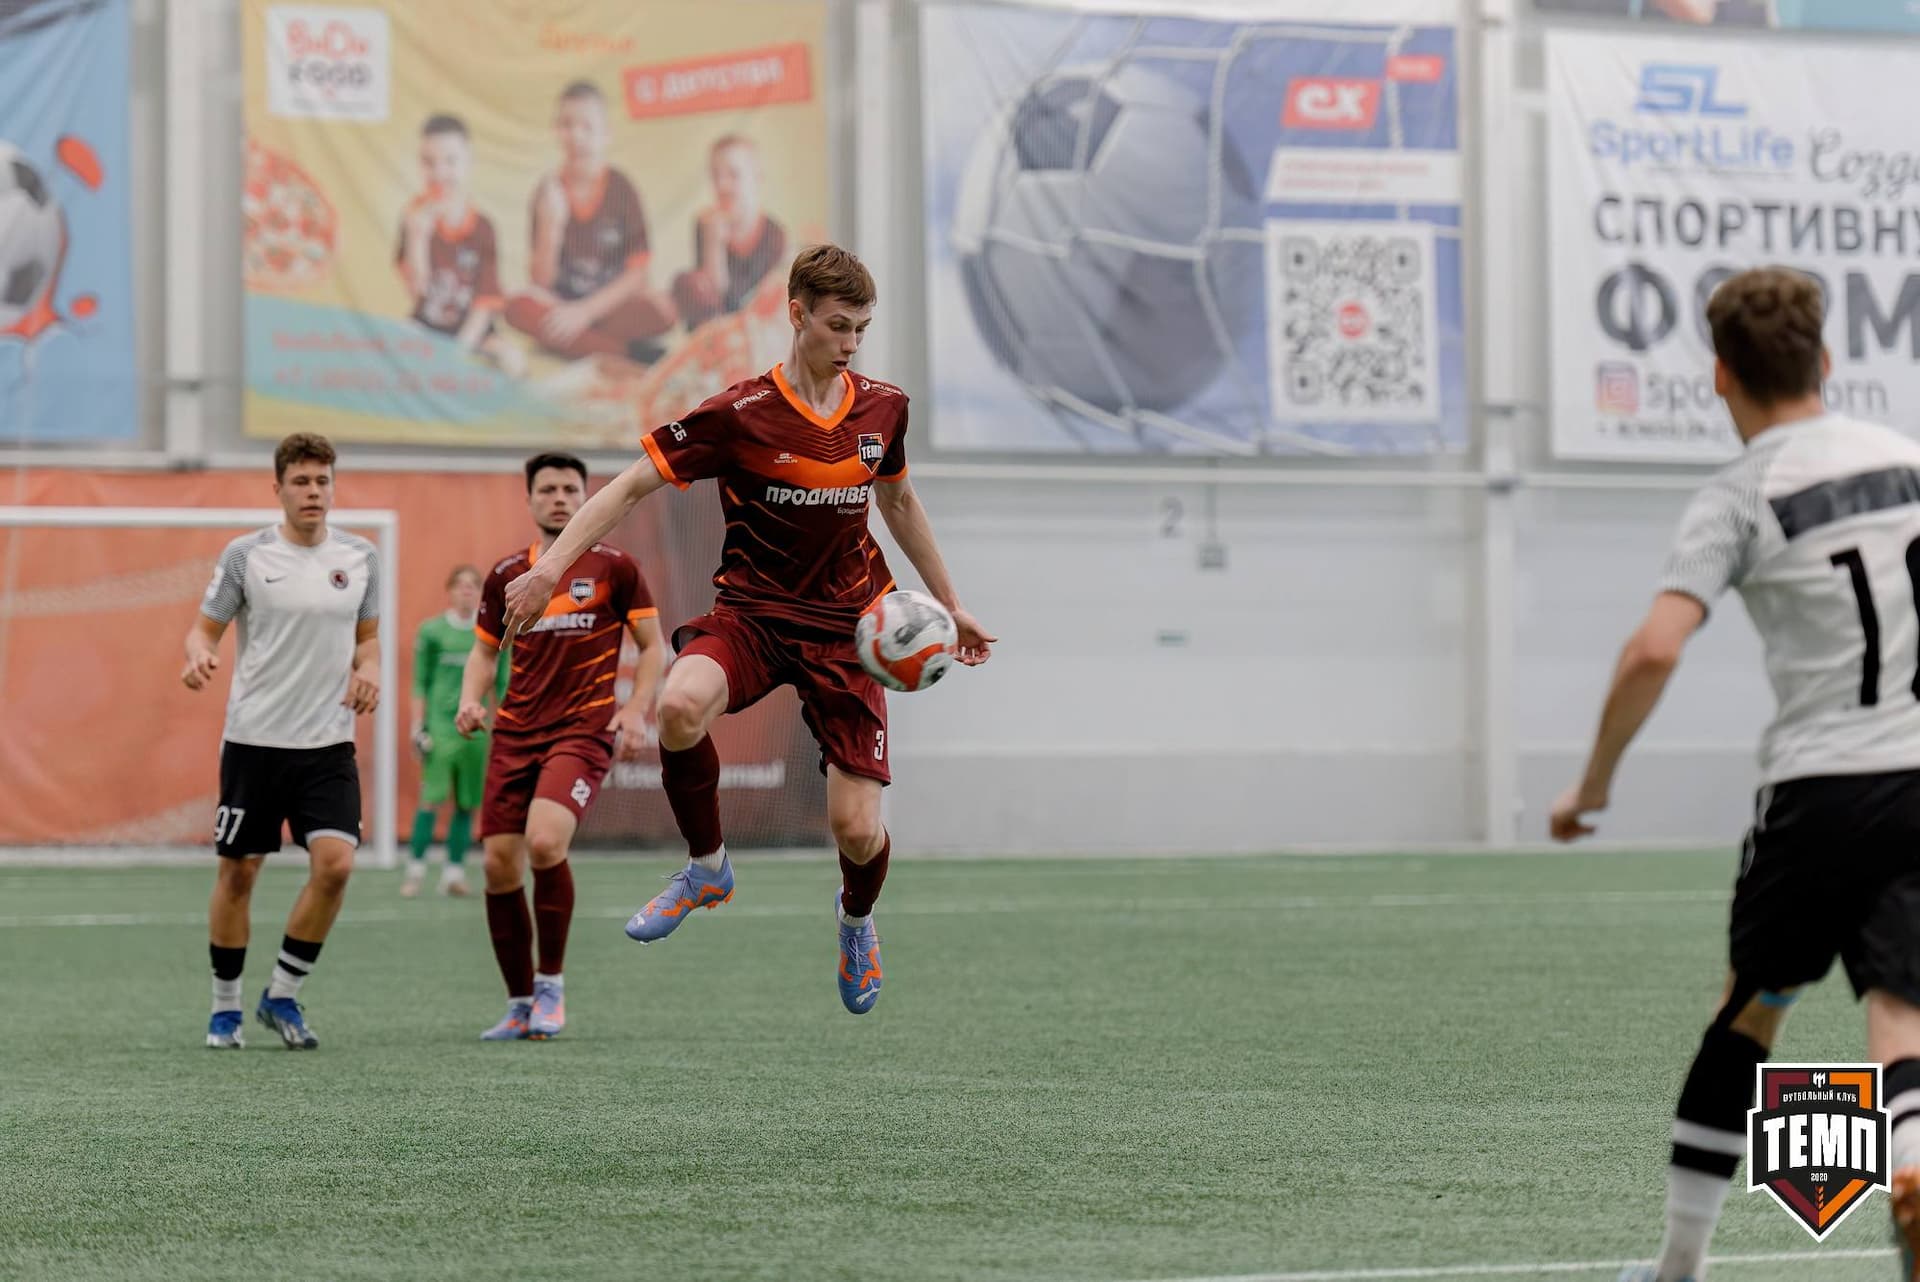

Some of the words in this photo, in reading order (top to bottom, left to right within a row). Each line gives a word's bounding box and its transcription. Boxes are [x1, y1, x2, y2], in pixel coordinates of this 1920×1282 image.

[1634, 63, 1749, 116] SL
[1590, 121, 1795, 168] SportLife
[873, 730, 885, 760] 3
[214, 805, 246, 846] 97
